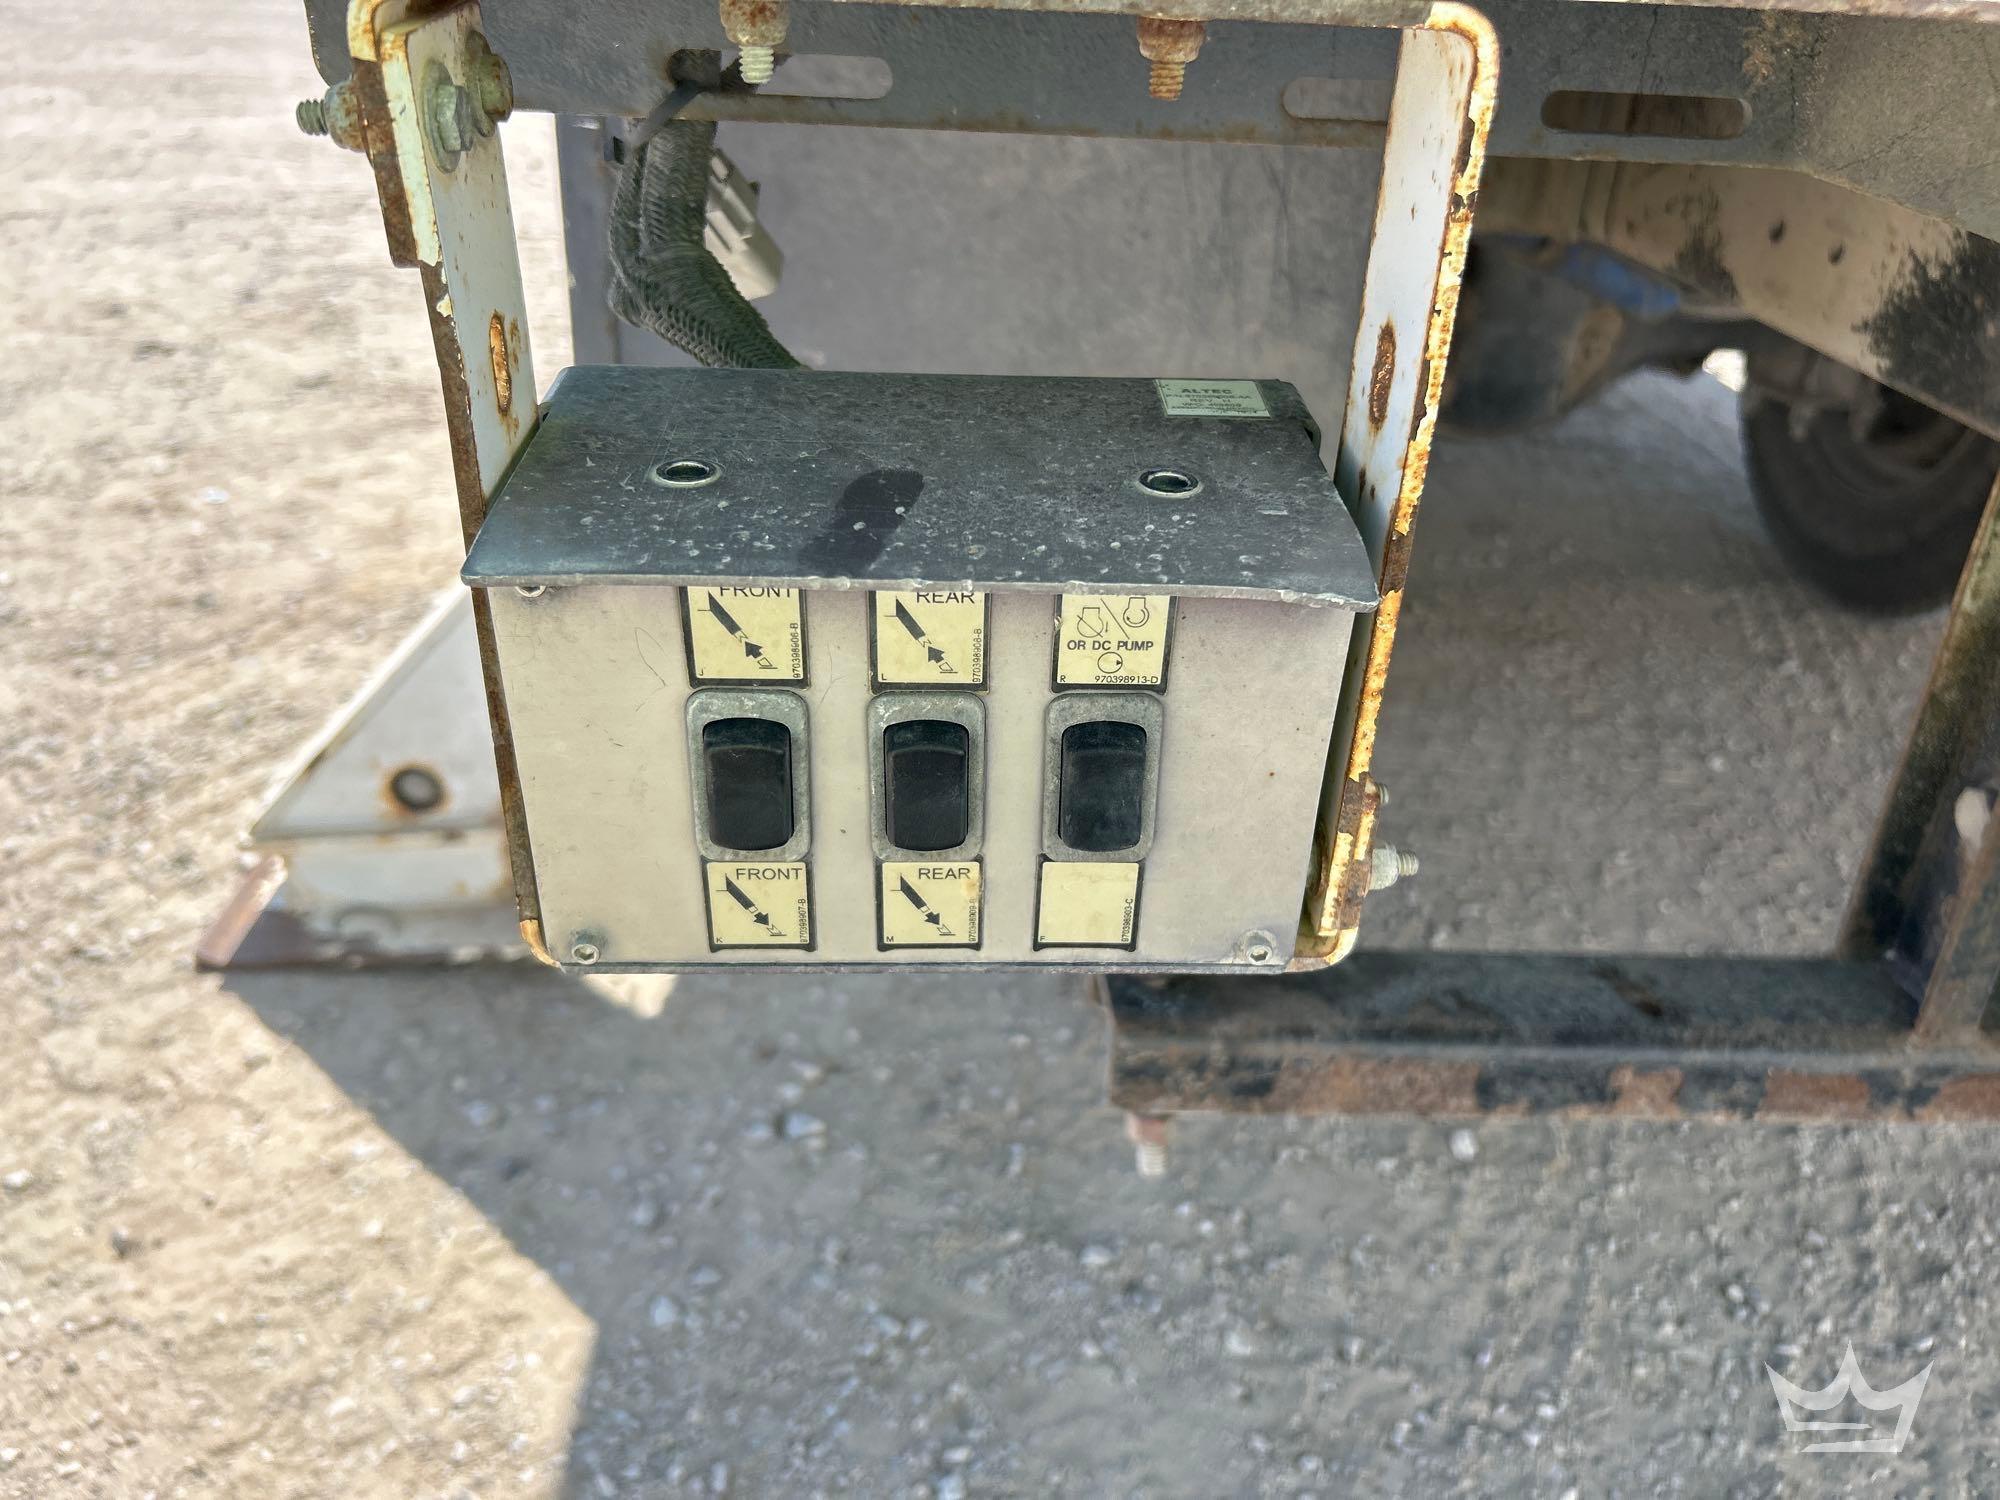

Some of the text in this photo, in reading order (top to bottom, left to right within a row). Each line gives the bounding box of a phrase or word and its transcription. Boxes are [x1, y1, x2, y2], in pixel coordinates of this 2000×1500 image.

[720, 586, 791, 598] FRONT
[916, 592, 975, 604] REAR
[1067, 640, 1154, 651] OR DC PUMP
[881, 673, 887, 681] L
[1060, 675, 1066, 683] R
[1095, 675, 1159, 684] 970398913-D
[736, 868, 803, 880] FRONT
[918, 868, 971, 880] REAR
